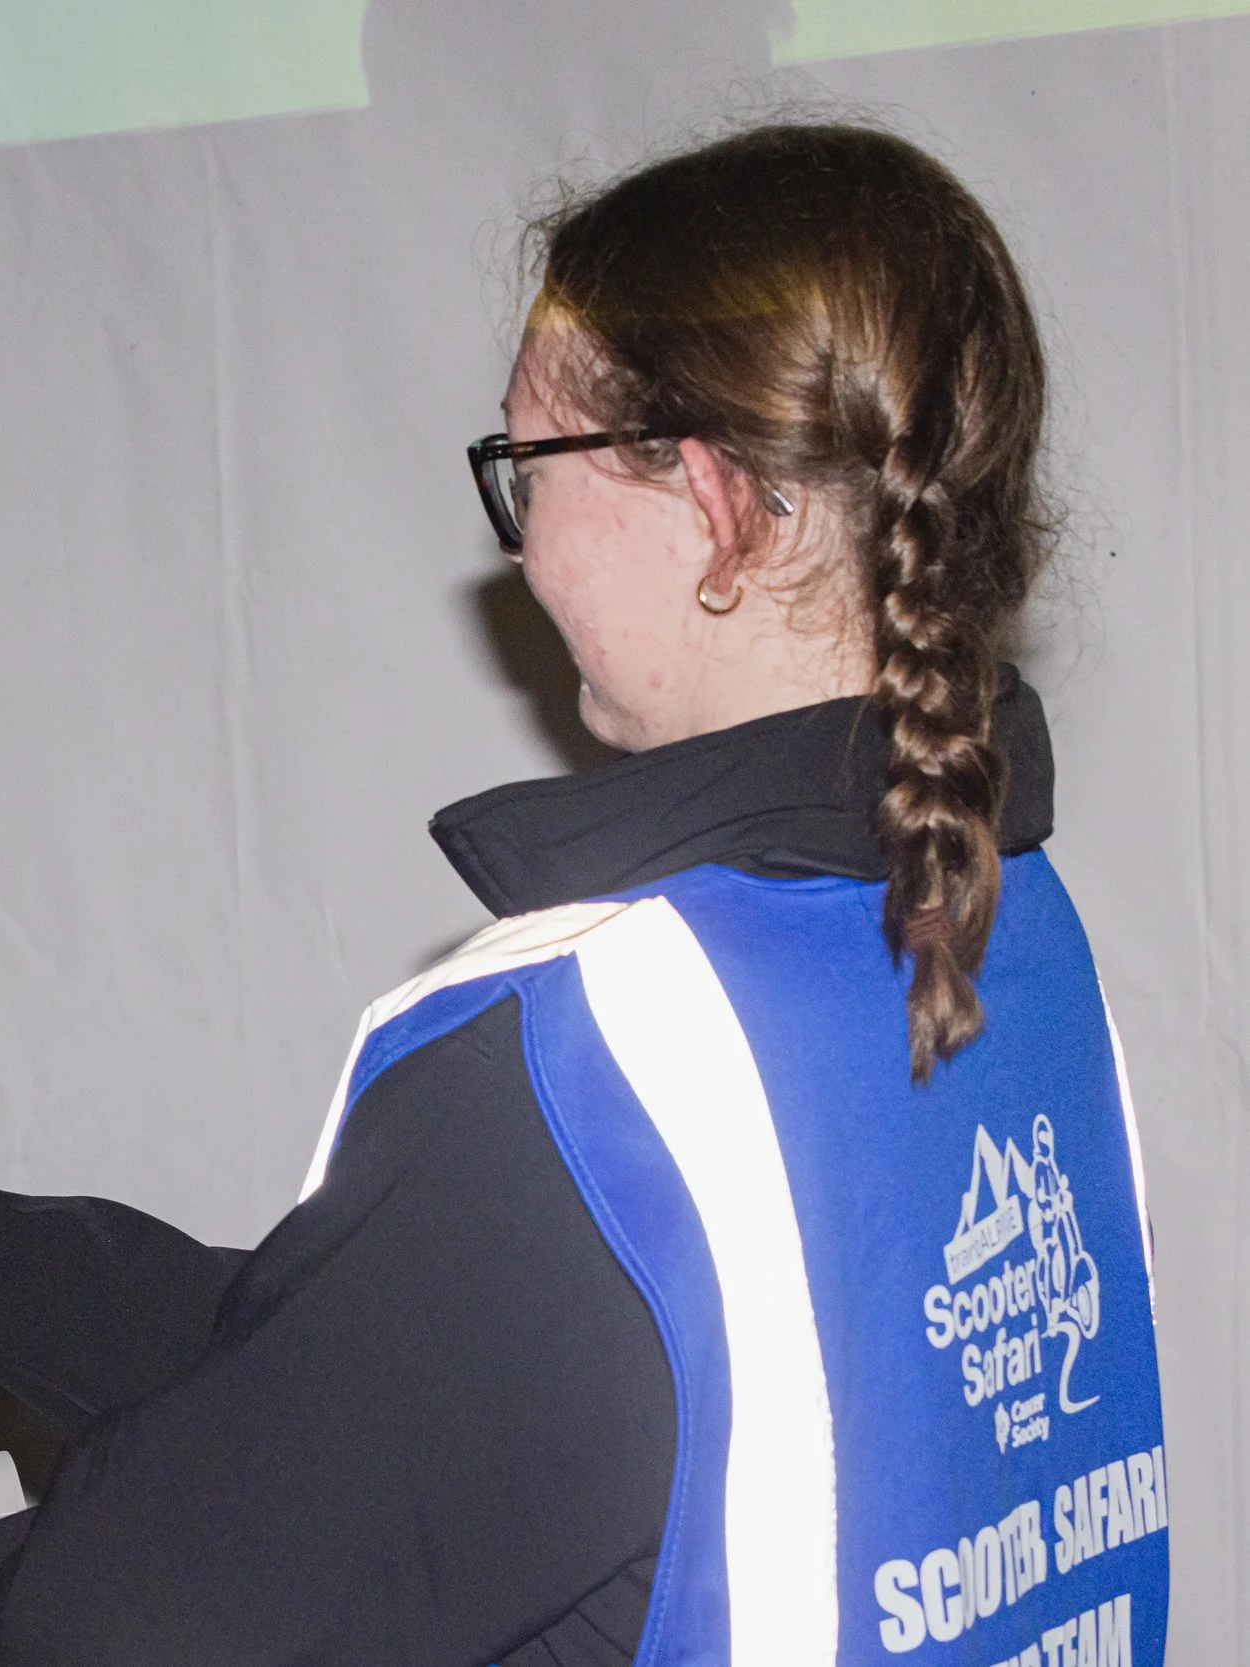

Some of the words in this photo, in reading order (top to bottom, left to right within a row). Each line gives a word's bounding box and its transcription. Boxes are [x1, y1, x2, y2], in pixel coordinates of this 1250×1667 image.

[923, 1257, 1038, 1349] Scooter
[961, 1313, 1042, 1407] Safari
[1011, 1415, 1050, 1449] Society
[873, 1499, 1048, 1655] SCOOTER
[1053, 1444, 1169, 1575] SAFARI
